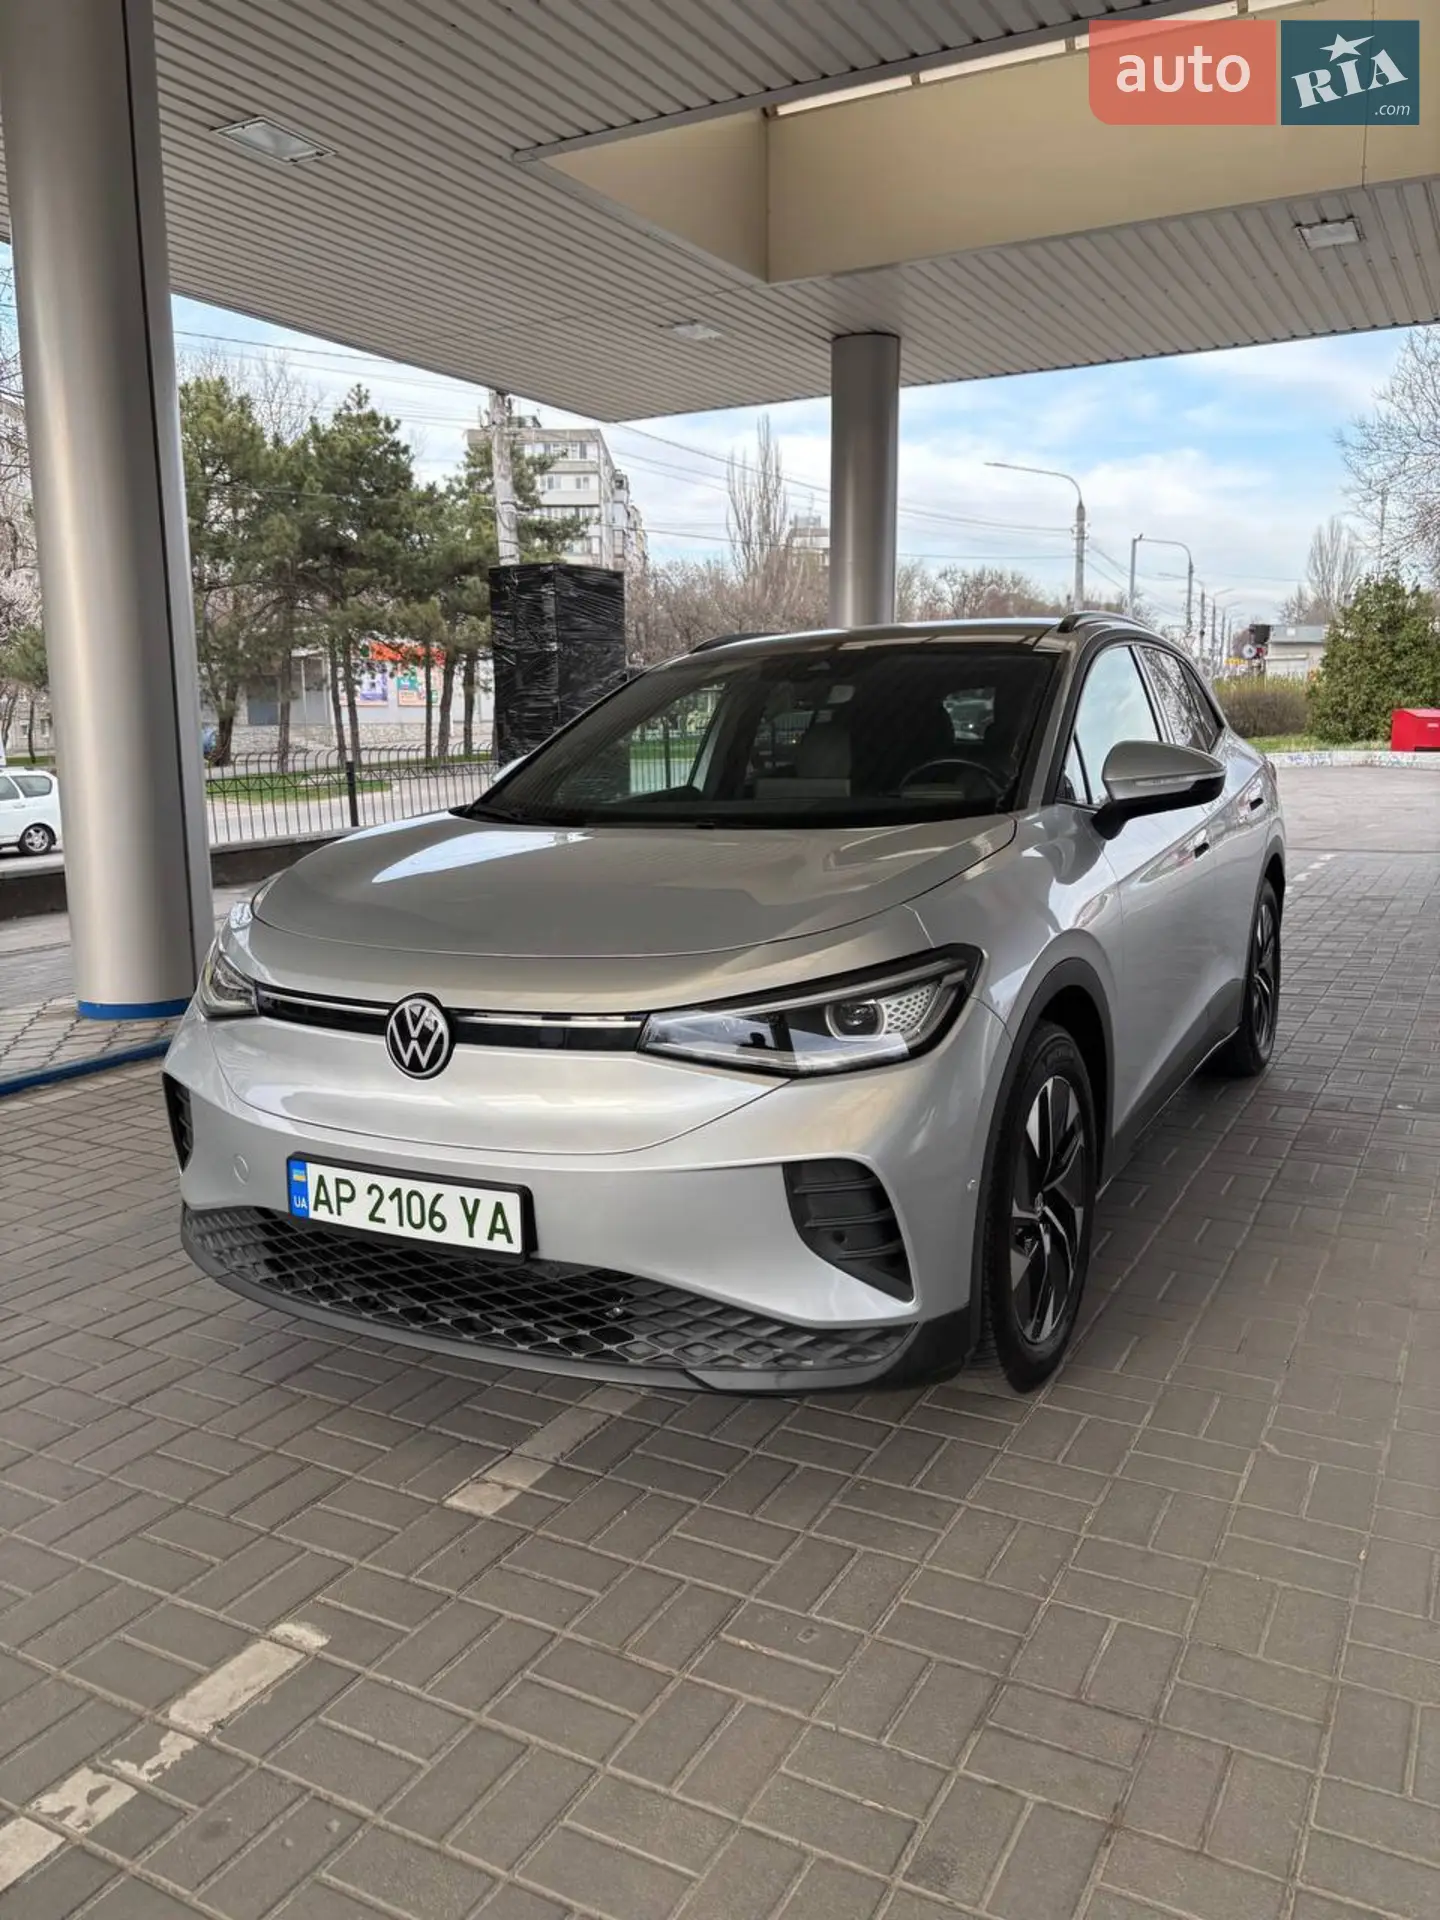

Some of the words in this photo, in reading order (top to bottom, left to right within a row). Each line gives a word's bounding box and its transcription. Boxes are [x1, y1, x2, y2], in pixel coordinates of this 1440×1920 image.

[389, 1001, 446, 1071] VW
[293, 1197, 307, 1210] UA
[313, 1174, 356, 1216] AP
[366, 1183, 447, 1233] 2106
[459, 1196, 514, 1244] YA
